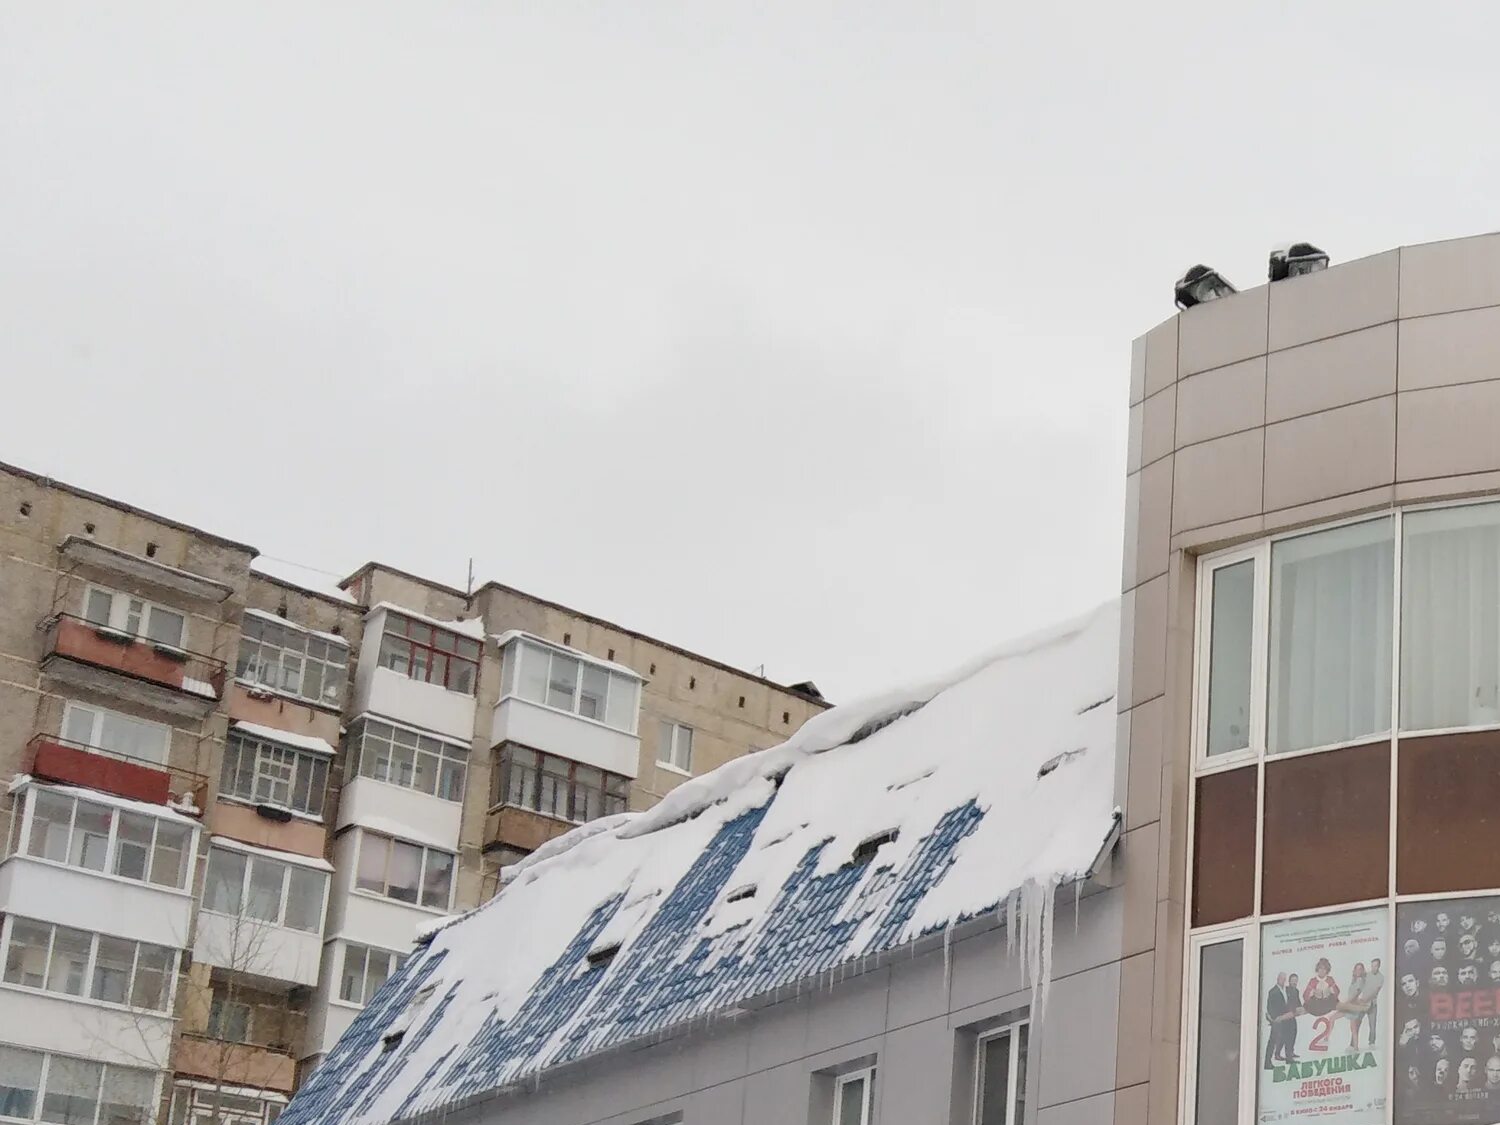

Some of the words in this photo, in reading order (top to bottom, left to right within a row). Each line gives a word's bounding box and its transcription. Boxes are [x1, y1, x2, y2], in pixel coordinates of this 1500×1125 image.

[1309, 1017, 1331, 1051] 2
[1272, 1052, 1378, 1083] БАБУШКА
[1293, 1084, 1351, 1099] ПОВЕДЕНИЯ
